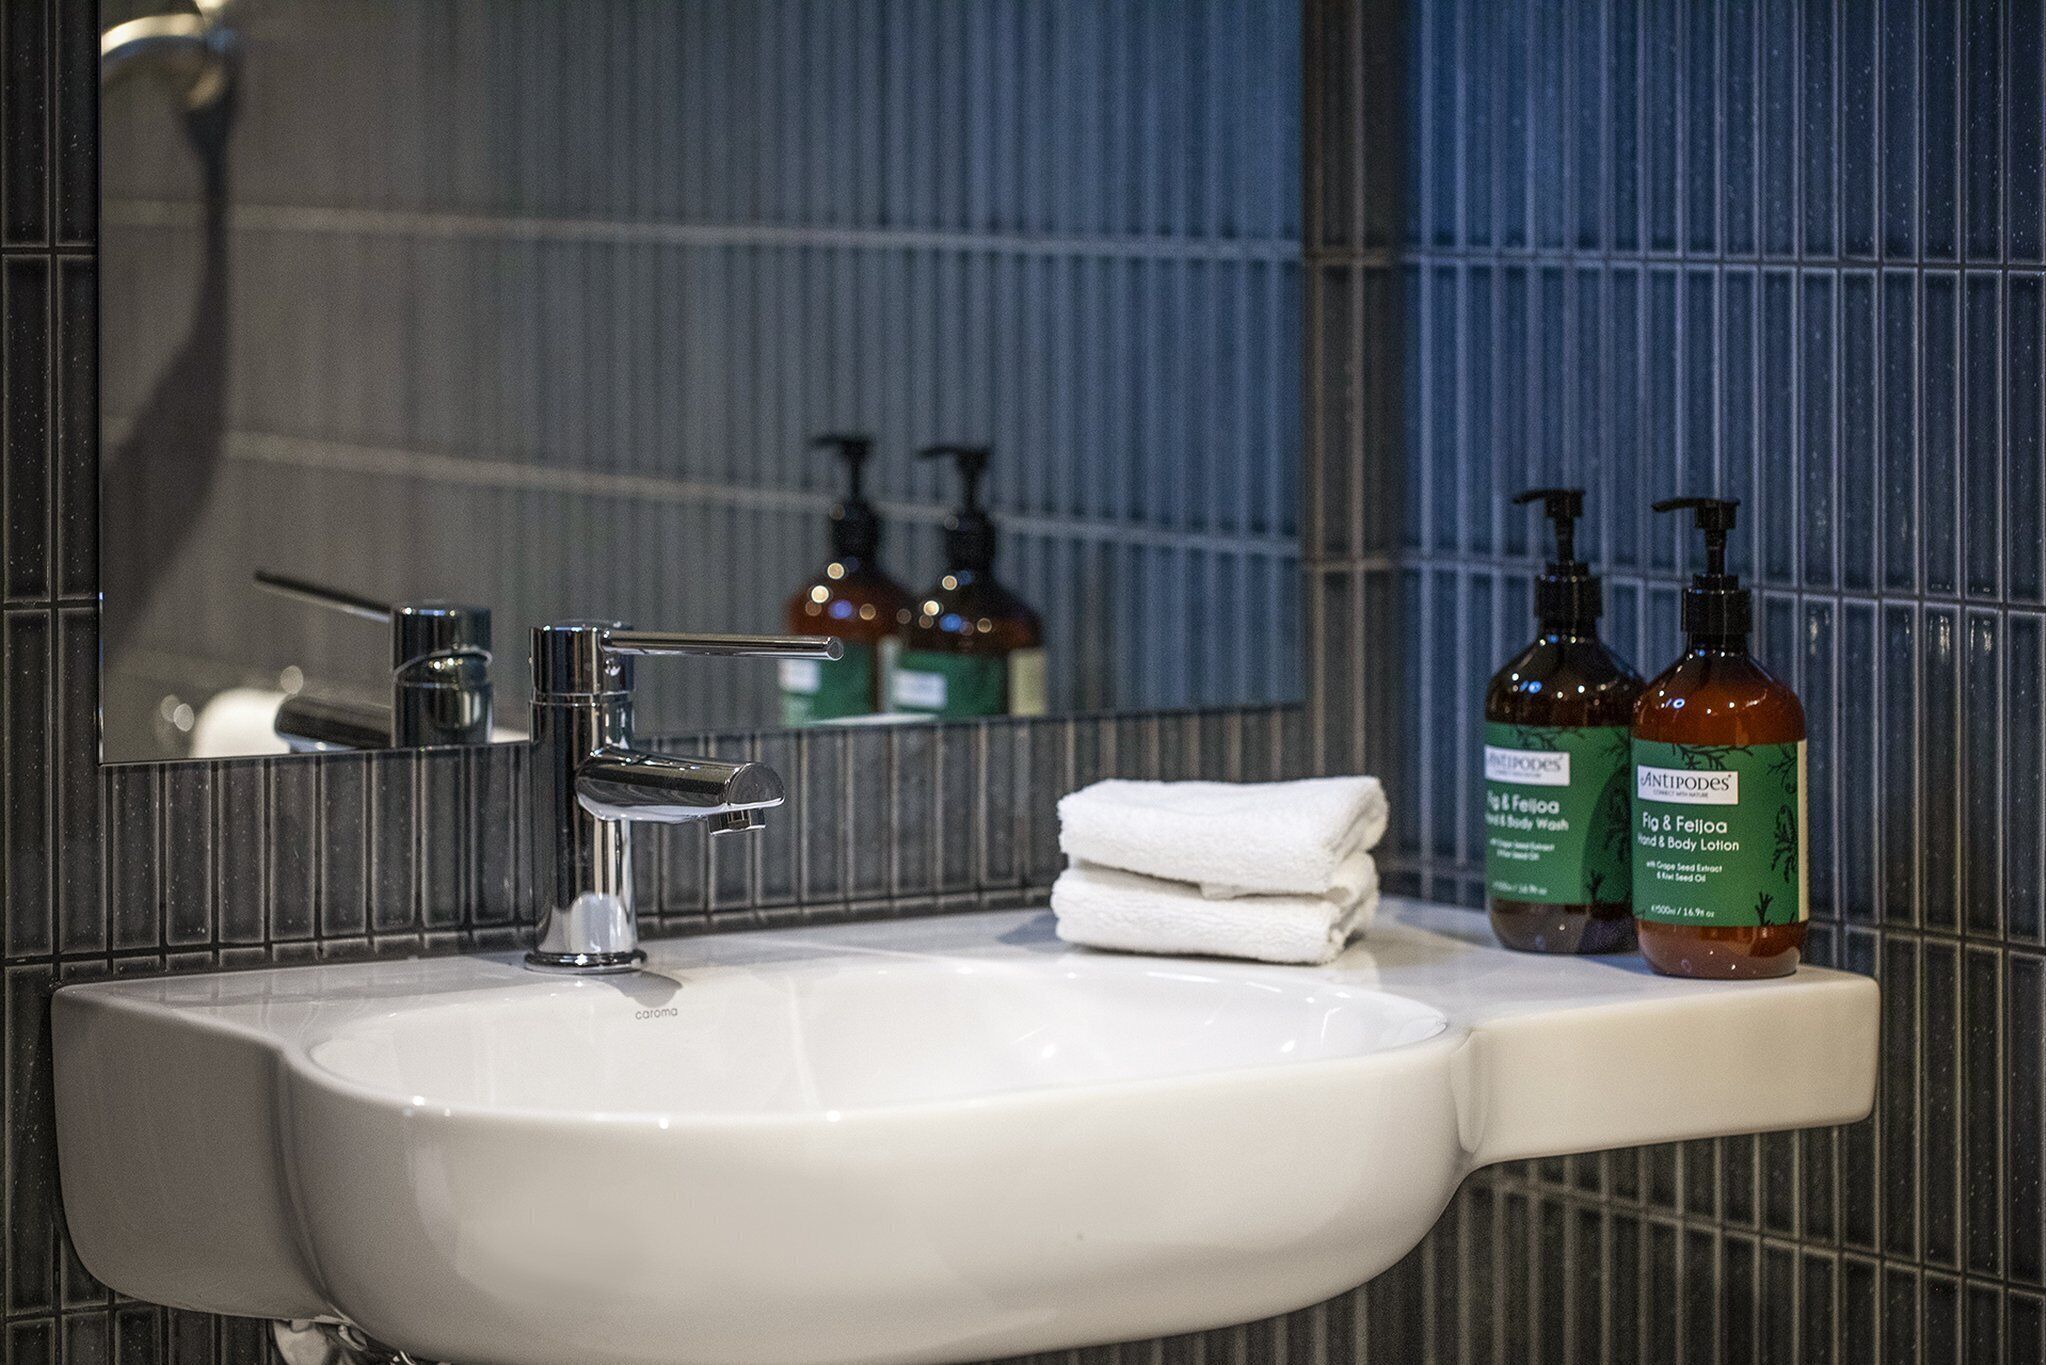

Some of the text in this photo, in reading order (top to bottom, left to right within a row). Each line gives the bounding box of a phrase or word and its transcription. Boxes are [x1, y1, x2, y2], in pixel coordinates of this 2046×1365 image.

[1512, 794, 1560, 814] Feijoa
[1535, 817, 1569, 831] Wash
[1642, 811, 1728, 835] Fig & Feijoa
[1658, 835, 1665, 848] &
[1667, 836, 1697, 852] Body
[1700, 838, 1740, 851] Lotion
[1656, 860, 1676, 871] Grape
[1677, 862, 1695, 872] Seed
[1696, 864, 1723, 873] Extract
[1675, 873, 1693, 882] Seed
[1694, 874, 1706, 883] Oil
[635, 1008, 678, 1020] caroma
